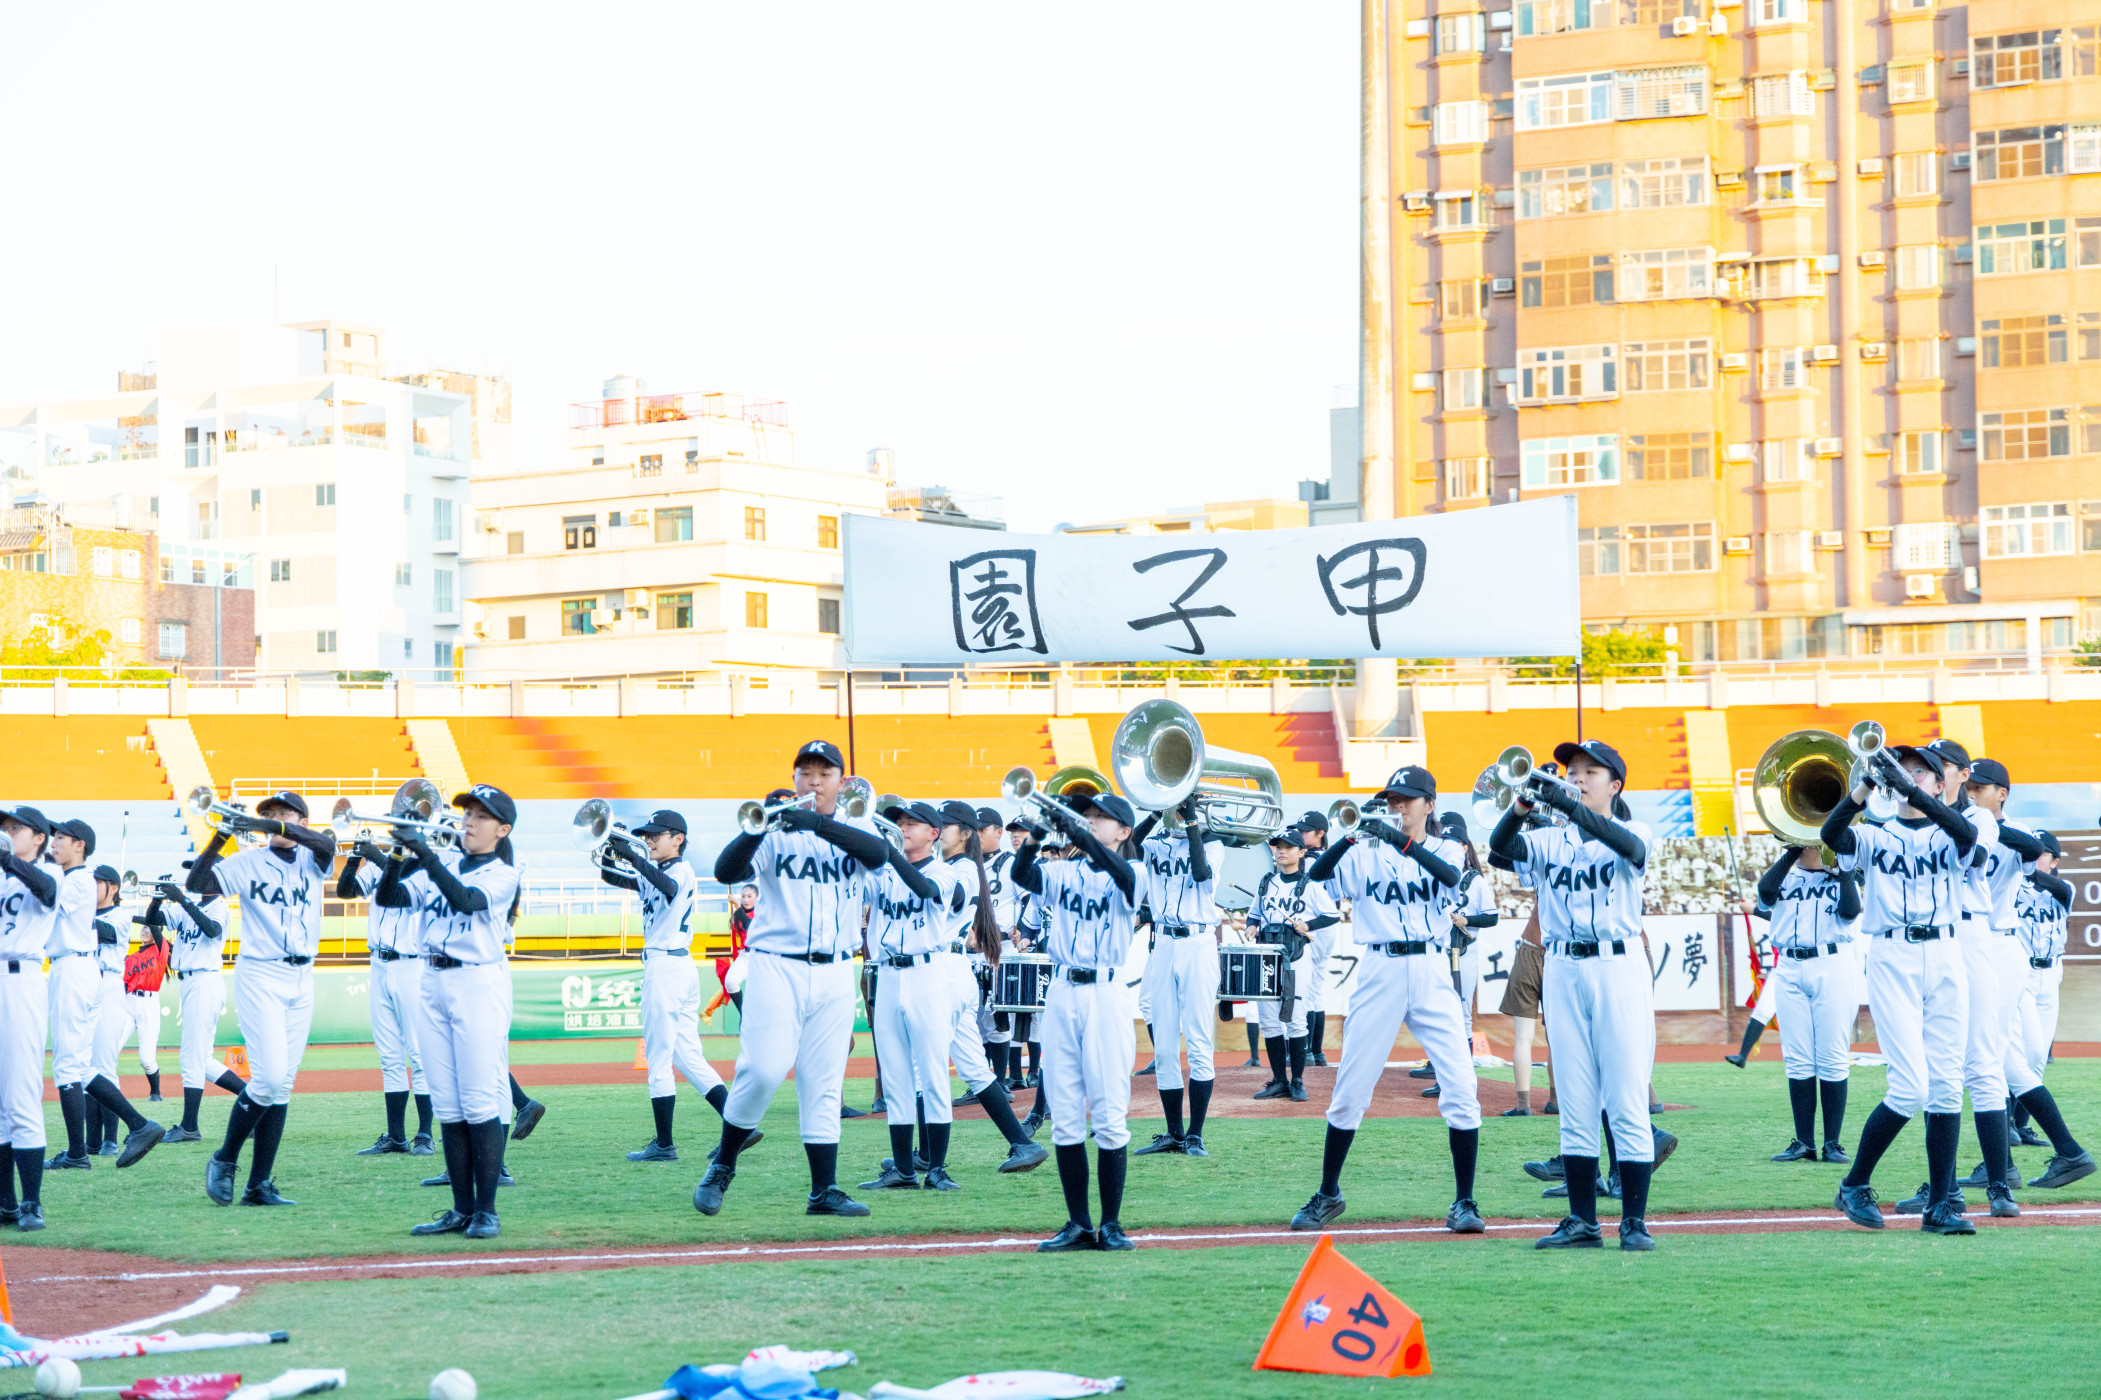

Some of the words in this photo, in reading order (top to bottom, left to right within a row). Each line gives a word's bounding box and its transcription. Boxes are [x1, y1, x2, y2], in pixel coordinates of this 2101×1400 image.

[807, 742, 826, 753] K
[1390, 771, 1409, 786] K
[1442, 826, 1454, 834] K
[775, 853, 856, 884] KANO
[1037, 972, 1051, 1004] Pearl
[1261, 961, 1276, 993] Pearl
[1332, 1292, 1390, 1362] 40
